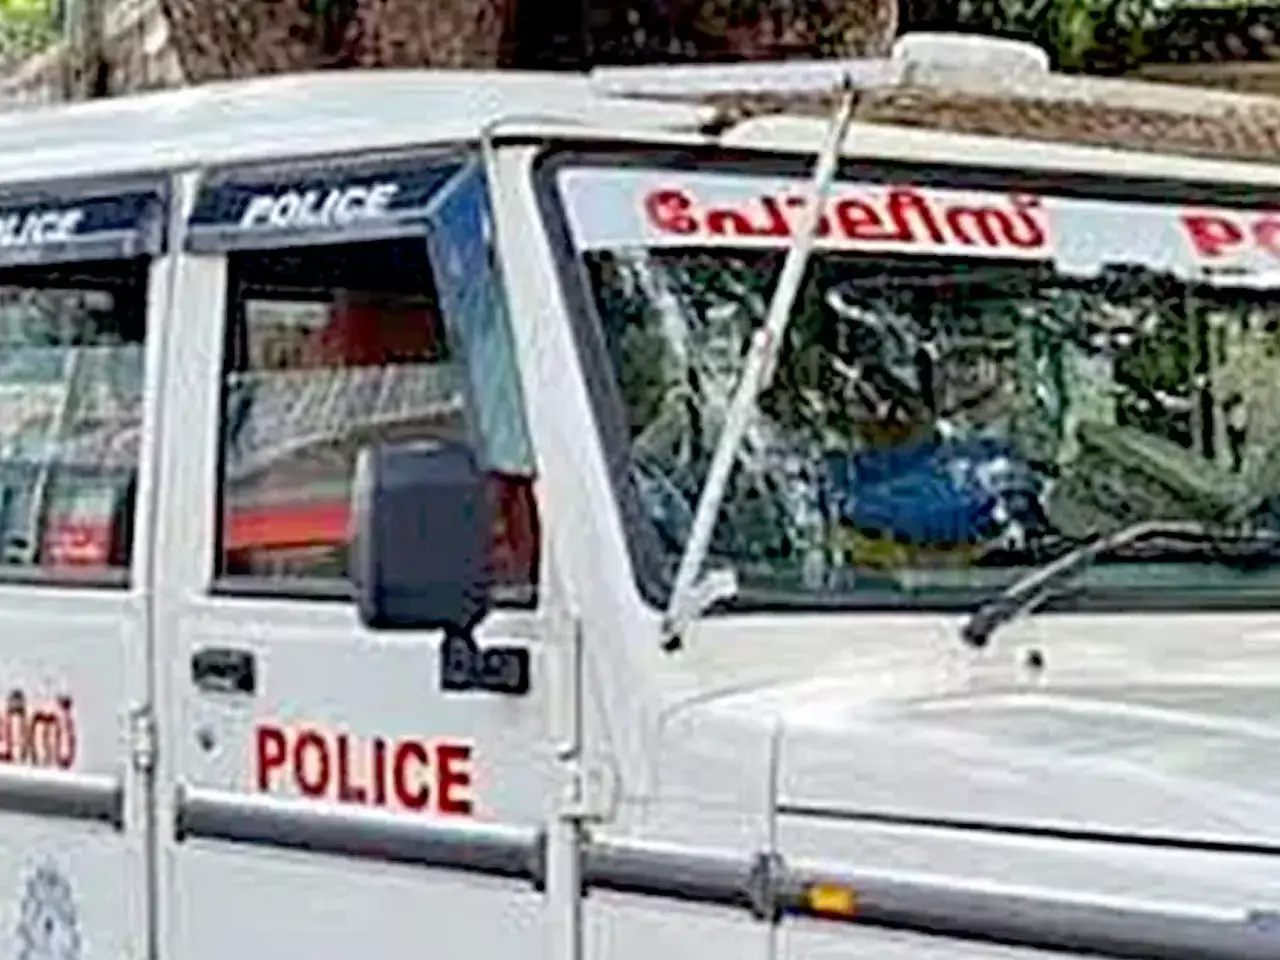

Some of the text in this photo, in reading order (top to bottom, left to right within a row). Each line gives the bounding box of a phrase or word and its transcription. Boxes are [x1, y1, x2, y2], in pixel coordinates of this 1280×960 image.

[0, 208, 83, 246] LICE
[242, 183, 398, 229] POLICE
[255, 724, 472, 816] POLICE
